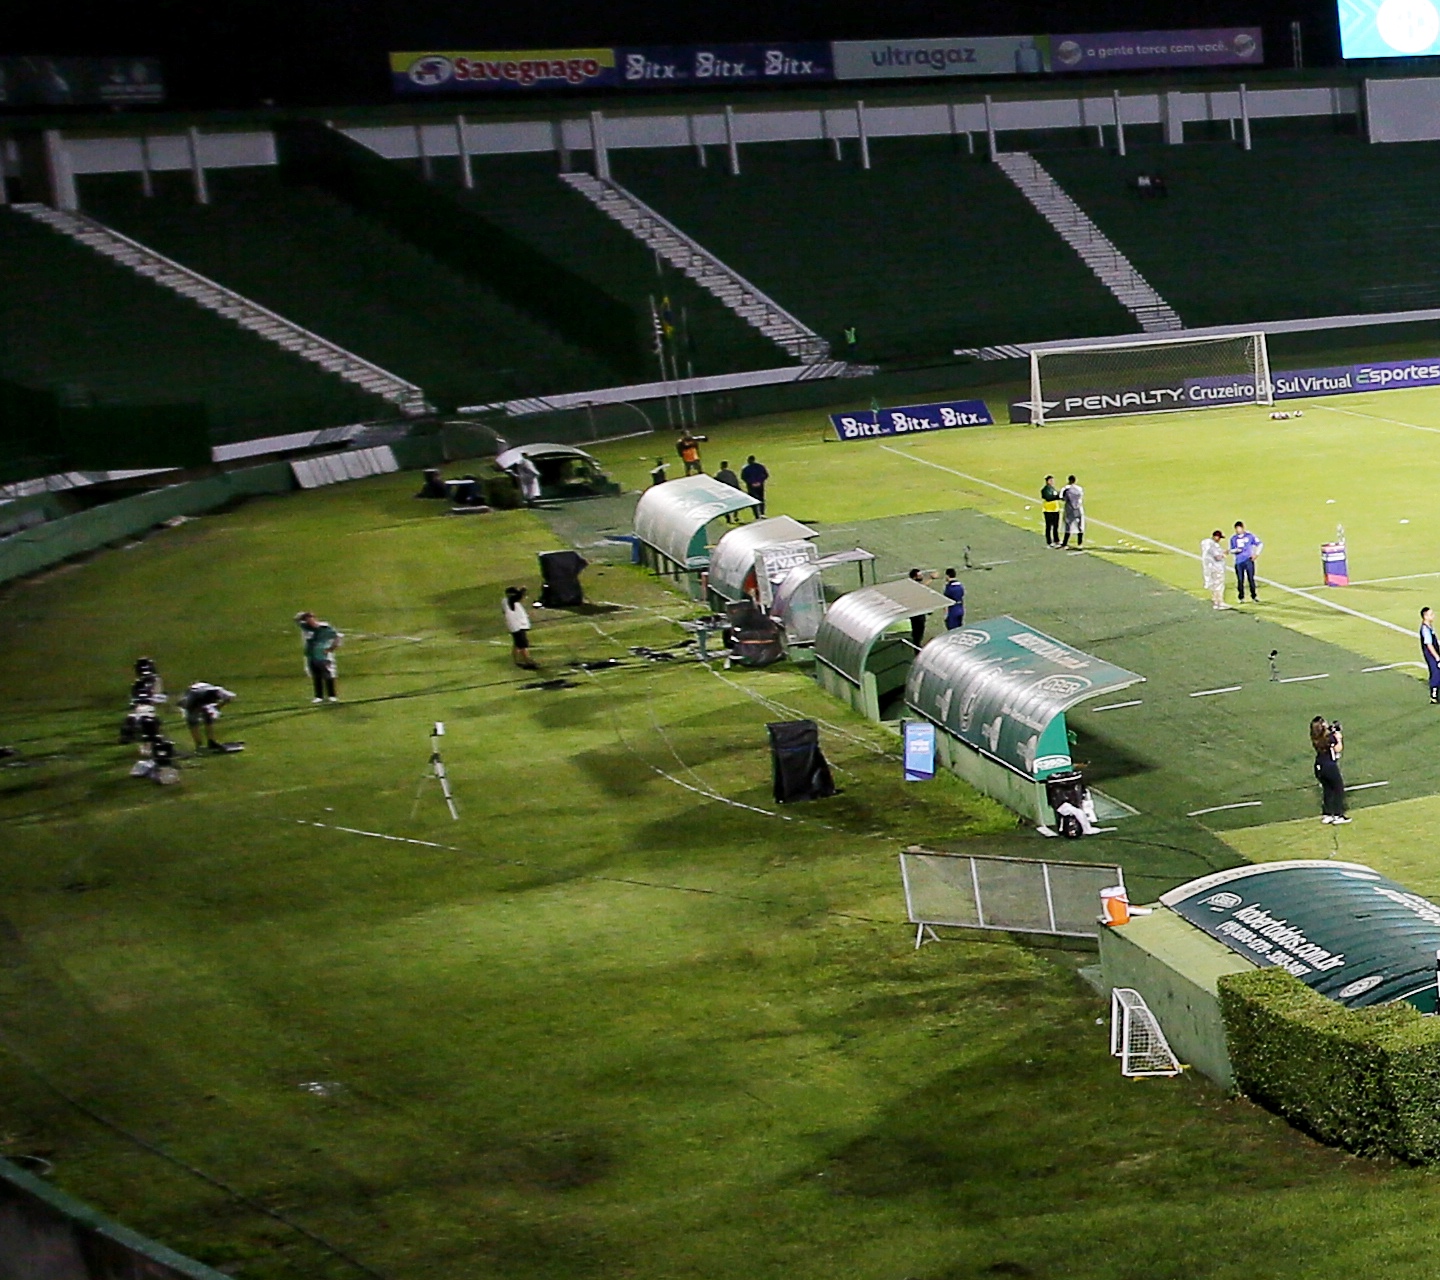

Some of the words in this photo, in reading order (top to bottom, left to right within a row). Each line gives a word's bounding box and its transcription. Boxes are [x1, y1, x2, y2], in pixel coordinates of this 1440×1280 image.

[872, 46, 977, 69] ultragaz
[1087, 48, 1096, 57] a
[1098, 46, 1133, 59] gente
[455, 57, 600, 86] Savegnago
[1189, 379, 1254, 400] Cruzeiro
[1277, 377, 1300, 394] Sul
[1300, 373, 1352, 392] Virtual
[1065, 388, 1183, 412] PENALTY
